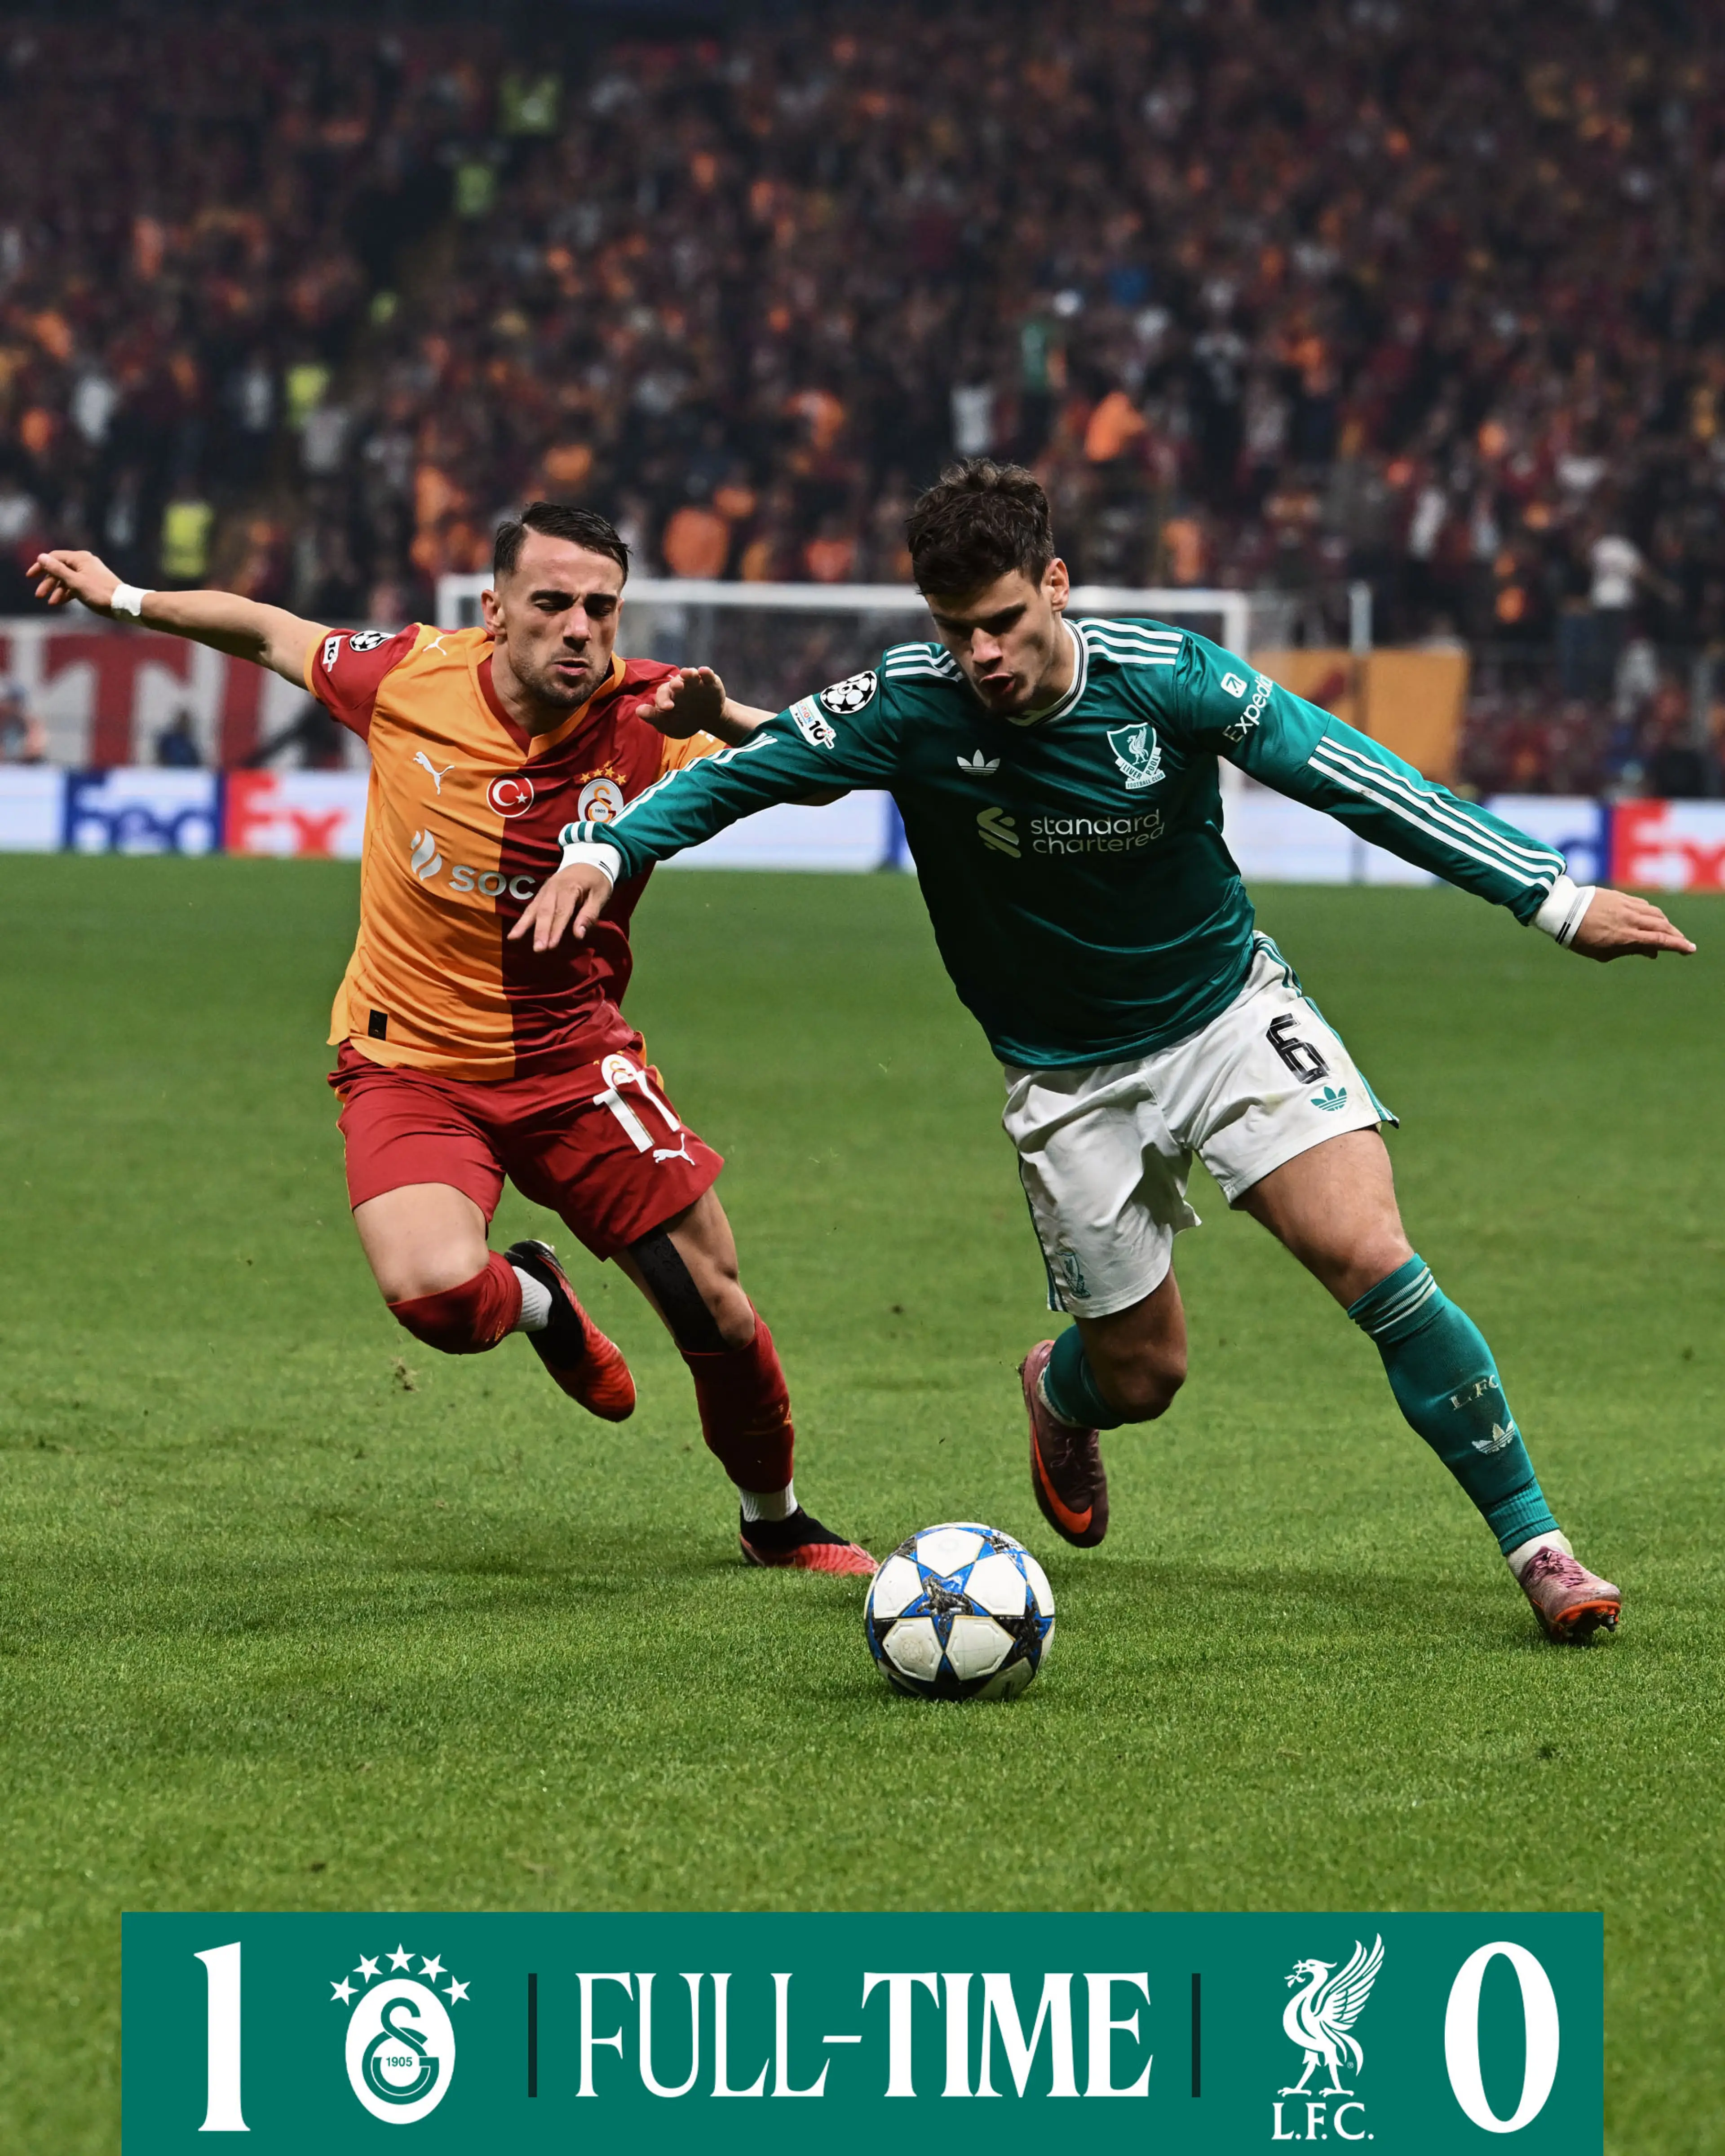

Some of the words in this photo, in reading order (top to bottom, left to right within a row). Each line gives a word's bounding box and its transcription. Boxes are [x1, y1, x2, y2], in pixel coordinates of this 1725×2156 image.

[1122, 762, 1142, 780] LIVER
[1146, 757, 1159, 776] POOL
[1127, 779, 1151, 788] FOOTBALL
[1152, 773, 1164, 782] CLUB
[1031, 808, 1159, 835] standard
[1033, 822, 1165, 854] chartered
[449, 865, 536, 900] SOC
[1266, 1012, 1331, 1084] 6
